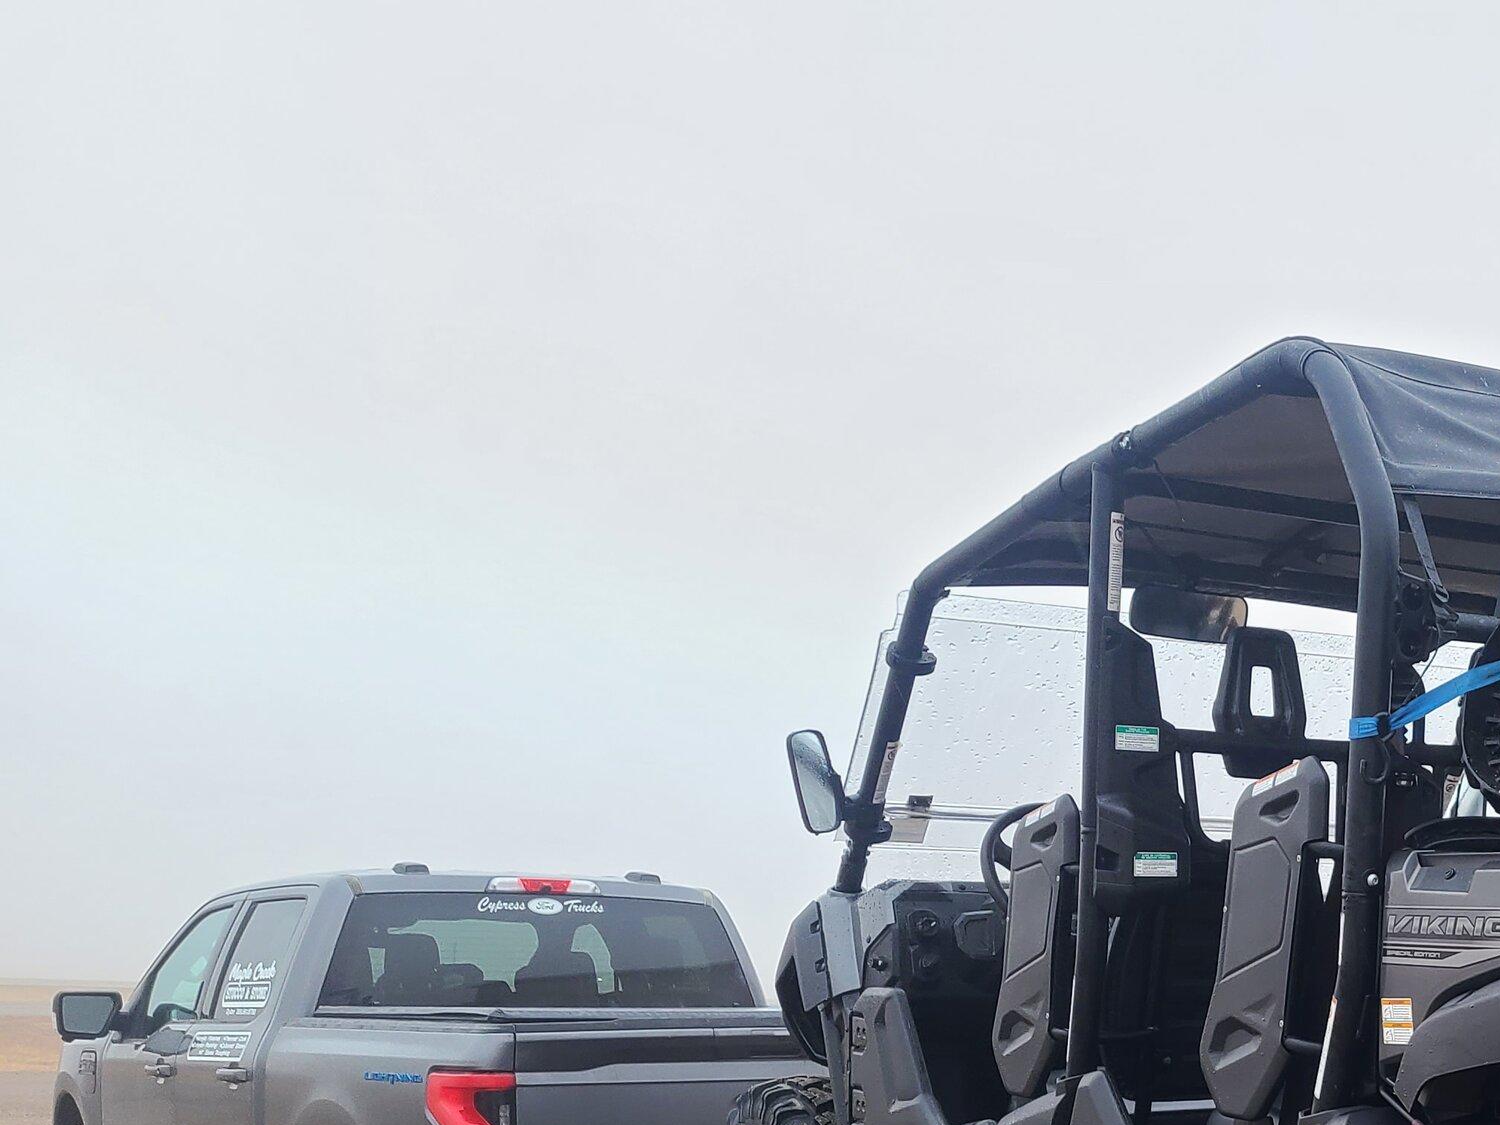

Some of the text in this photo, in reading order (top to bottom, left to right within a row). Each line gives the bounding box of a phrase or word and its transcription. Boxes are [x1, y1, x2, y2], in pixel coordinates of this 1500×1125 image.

[477, 897, 526, 912] Cypress
[563, 900, 605, 913] Trucks
[363, 1072, 424, 1085] LIGHTNING
